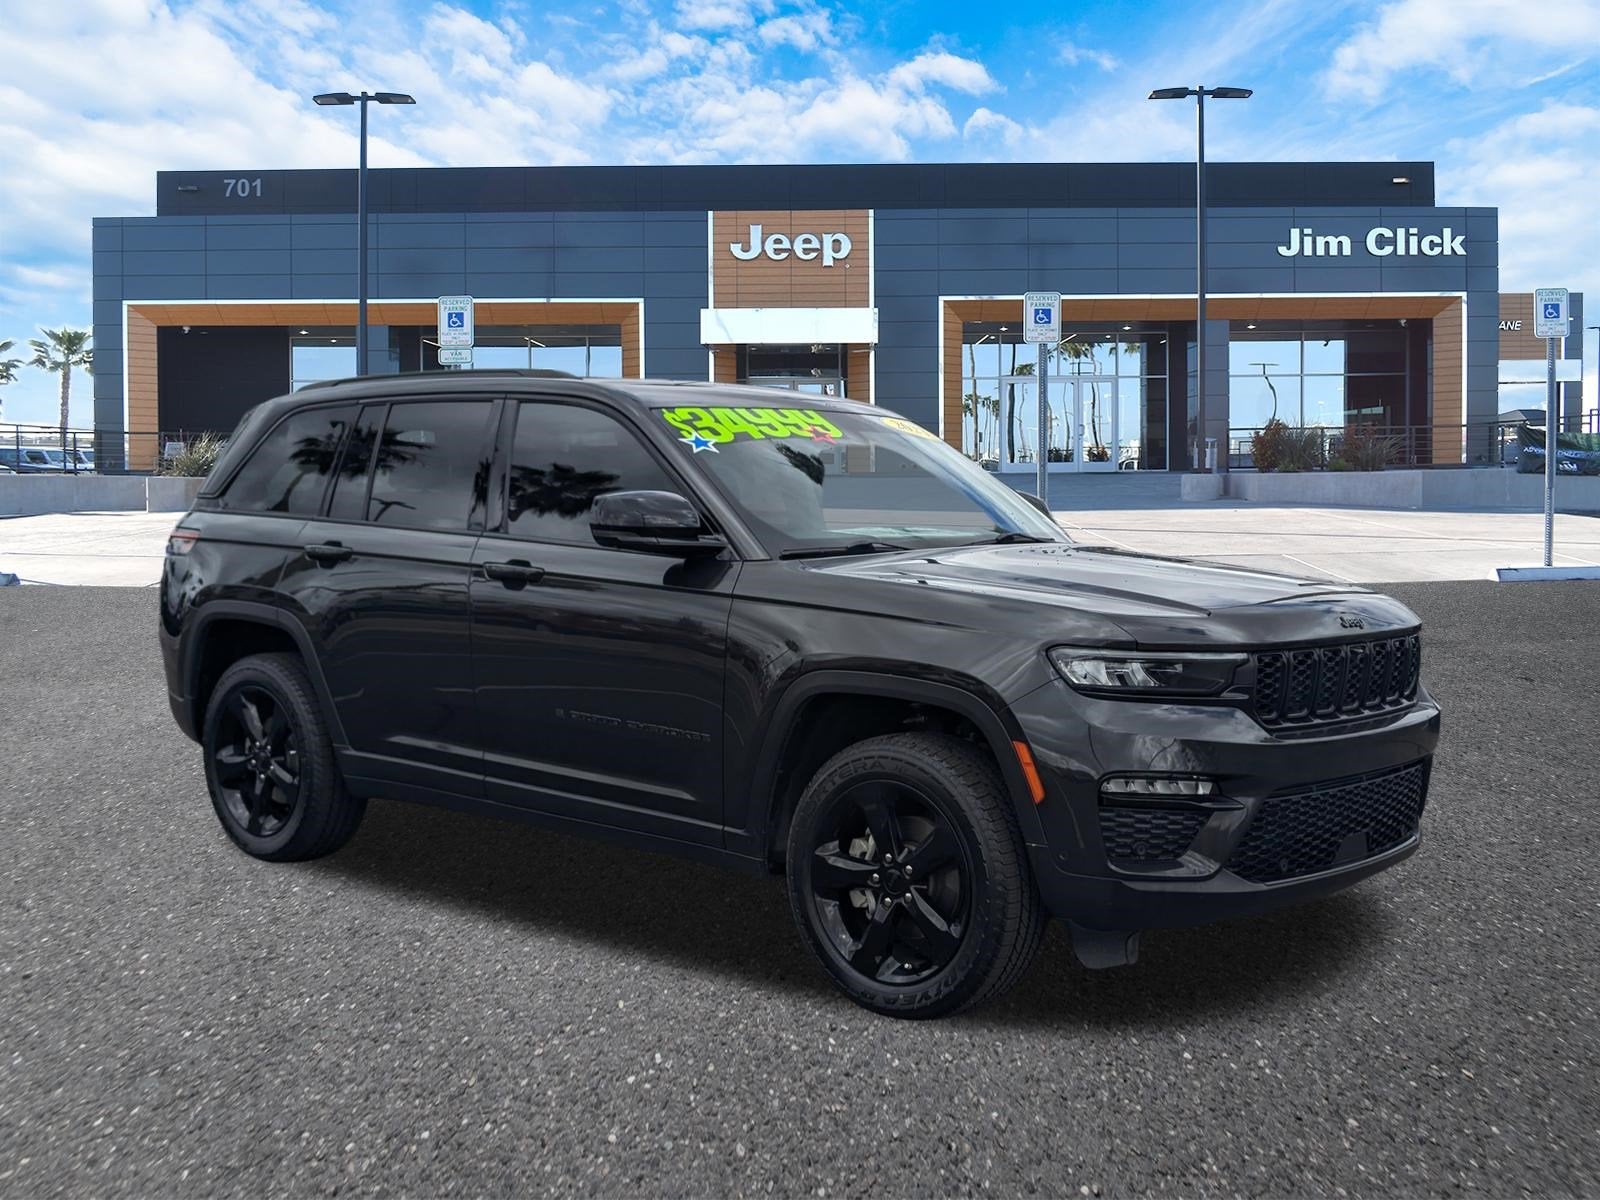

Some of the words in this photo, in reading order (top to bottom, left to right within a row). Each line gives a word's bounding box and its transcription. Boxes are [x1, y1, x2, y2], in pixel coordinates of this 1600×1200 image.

[223, 178, 261, 197] 701
[730, 224, 852, 267] Jeep
[1277, 228, 1352, 257] Jim
[1366, 227, 1467, 257] Click
